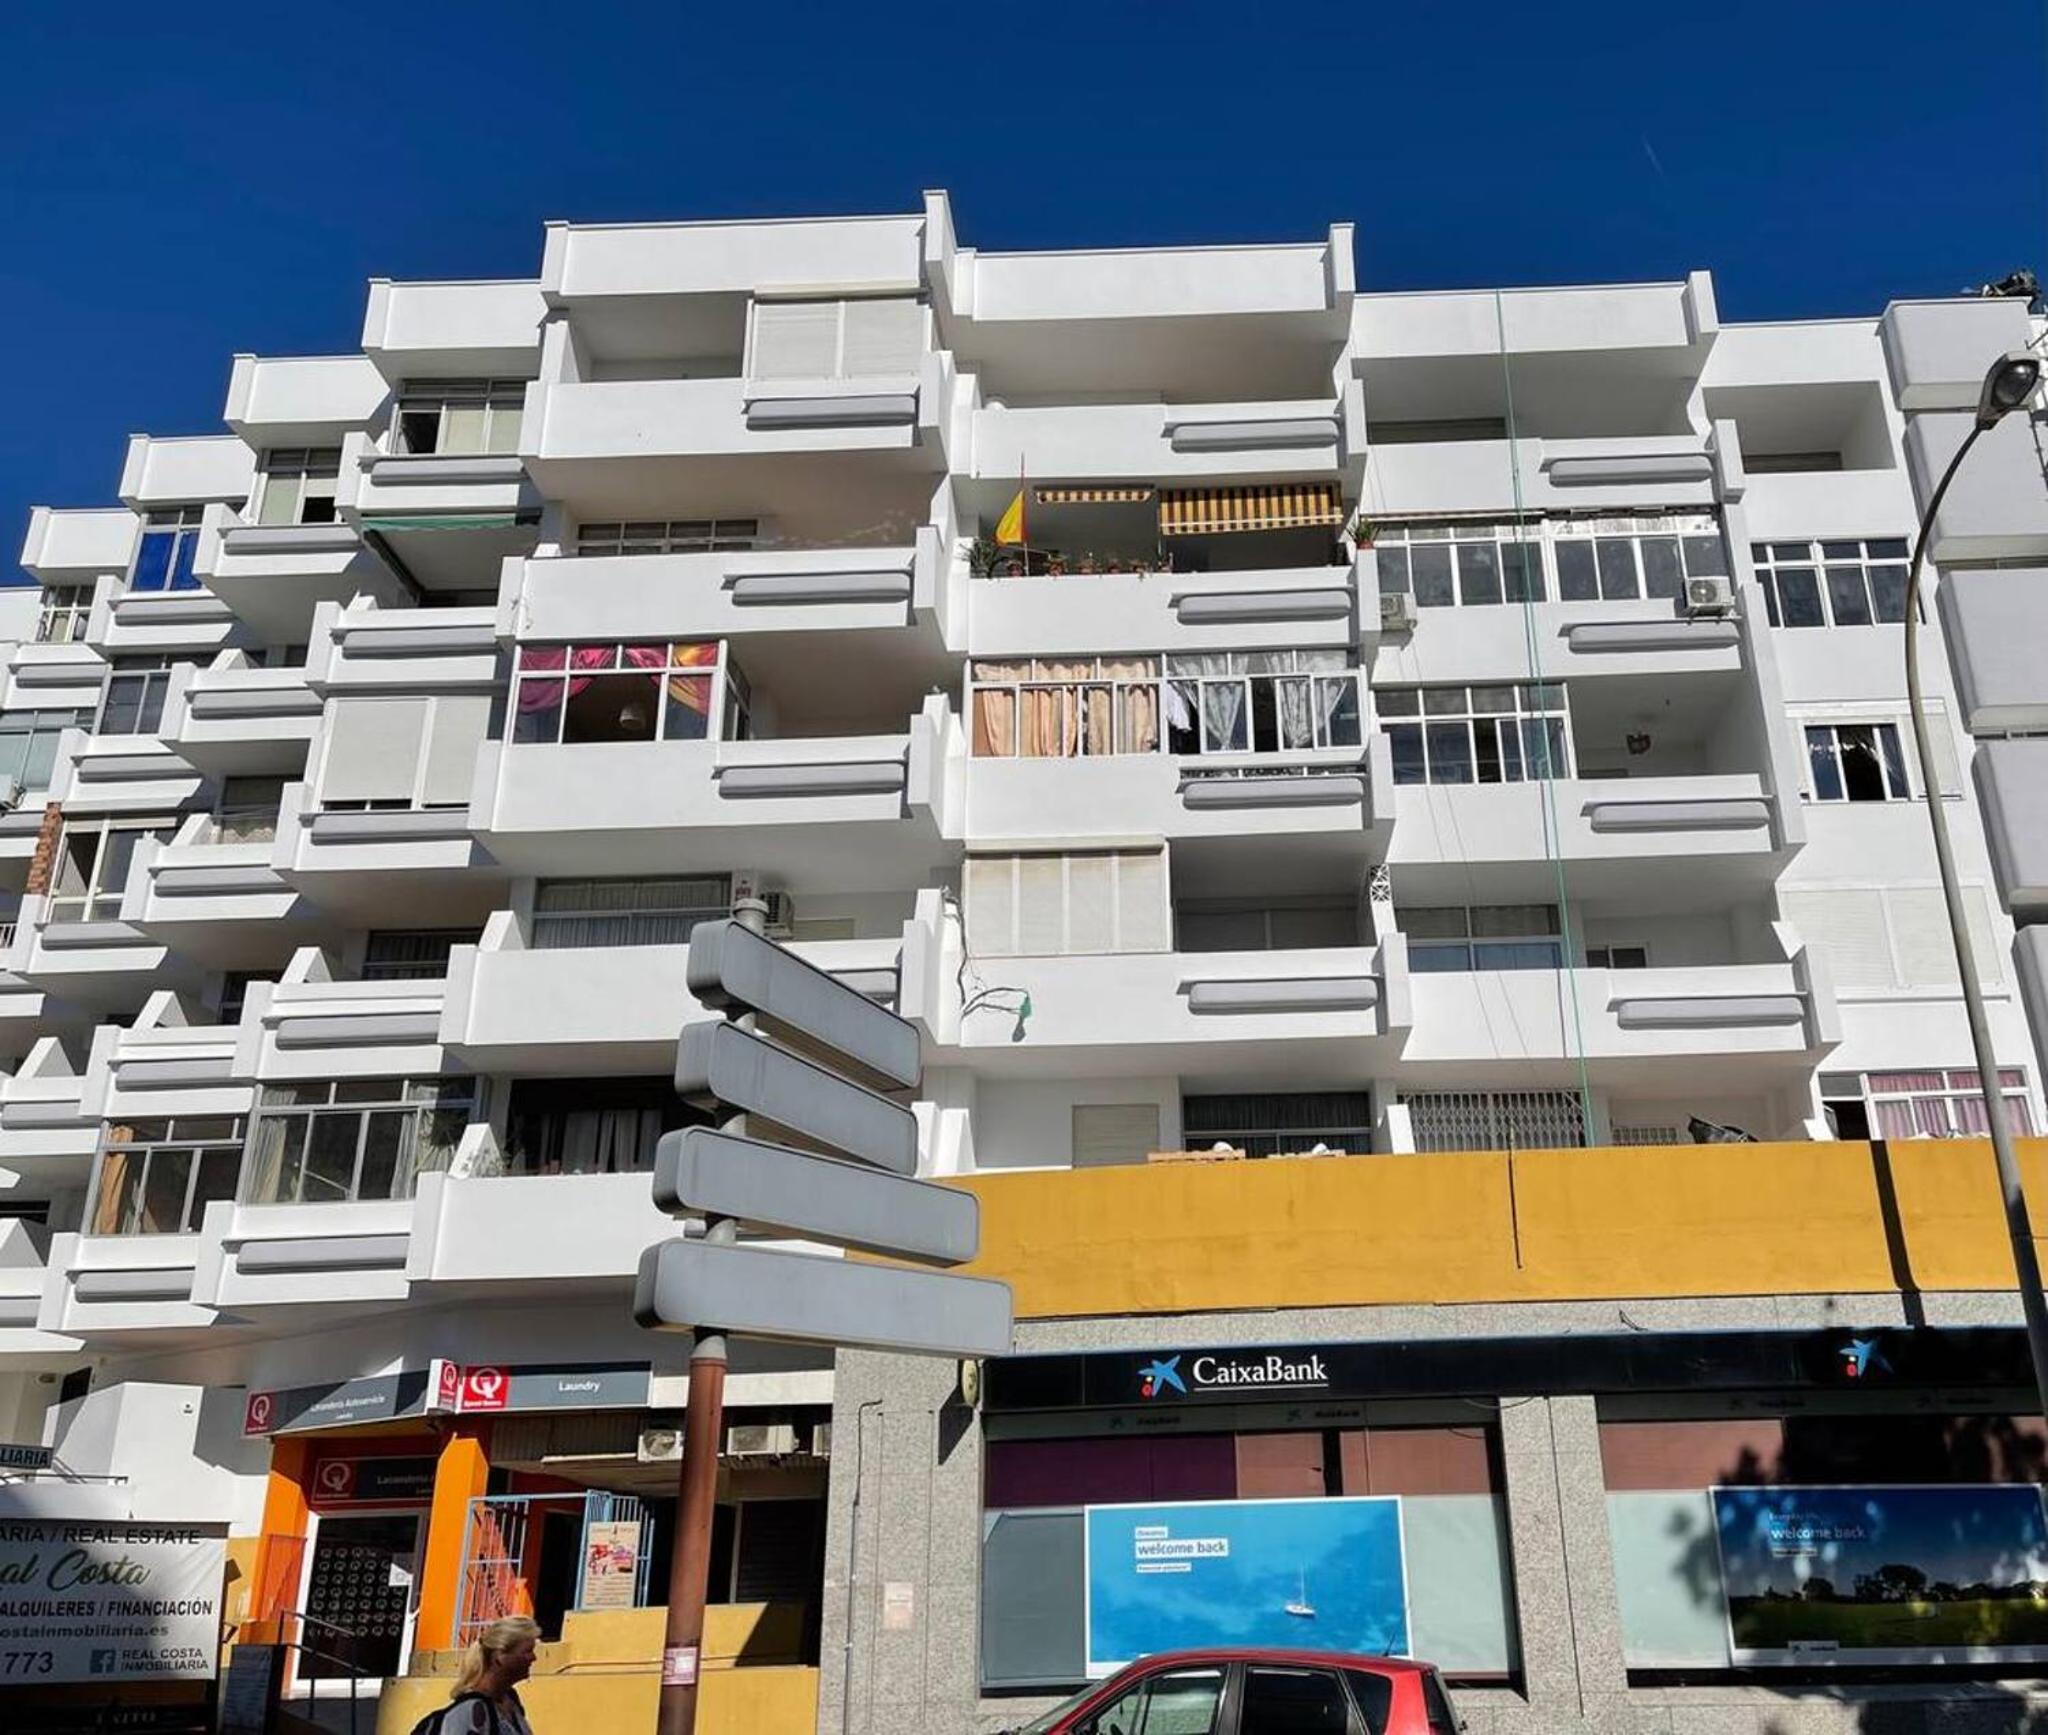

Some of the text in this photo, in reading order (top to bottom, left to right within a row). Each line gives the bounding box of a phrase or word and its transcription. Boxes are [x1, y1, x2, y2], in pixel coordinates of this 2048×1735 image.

[1193, 1355, 1328, 1384] CaixaBank
[470, 1367, 502, 1399] Q
[559, 1381, 600, 1393] Laundry
[63, 1527, 119, 1544] REAL
[125, 1528, 201, 1545] ESTATE
[1770, 1525, 1832, 1540] welcome
[1138, 1541, 1226, 1555] welcome back
[46, 1549, 151, 1592] Costa
[0, 1601, 95, 1617] ALQUILERES
[107, 1598, 213, 1616] FINANCIACIÓN
[5, 1651, 54, 1675] 773
[122, 1648, 203, 1660] REAL COSTA
[121, 1660, 209, 1672] INMOBILIARIA
